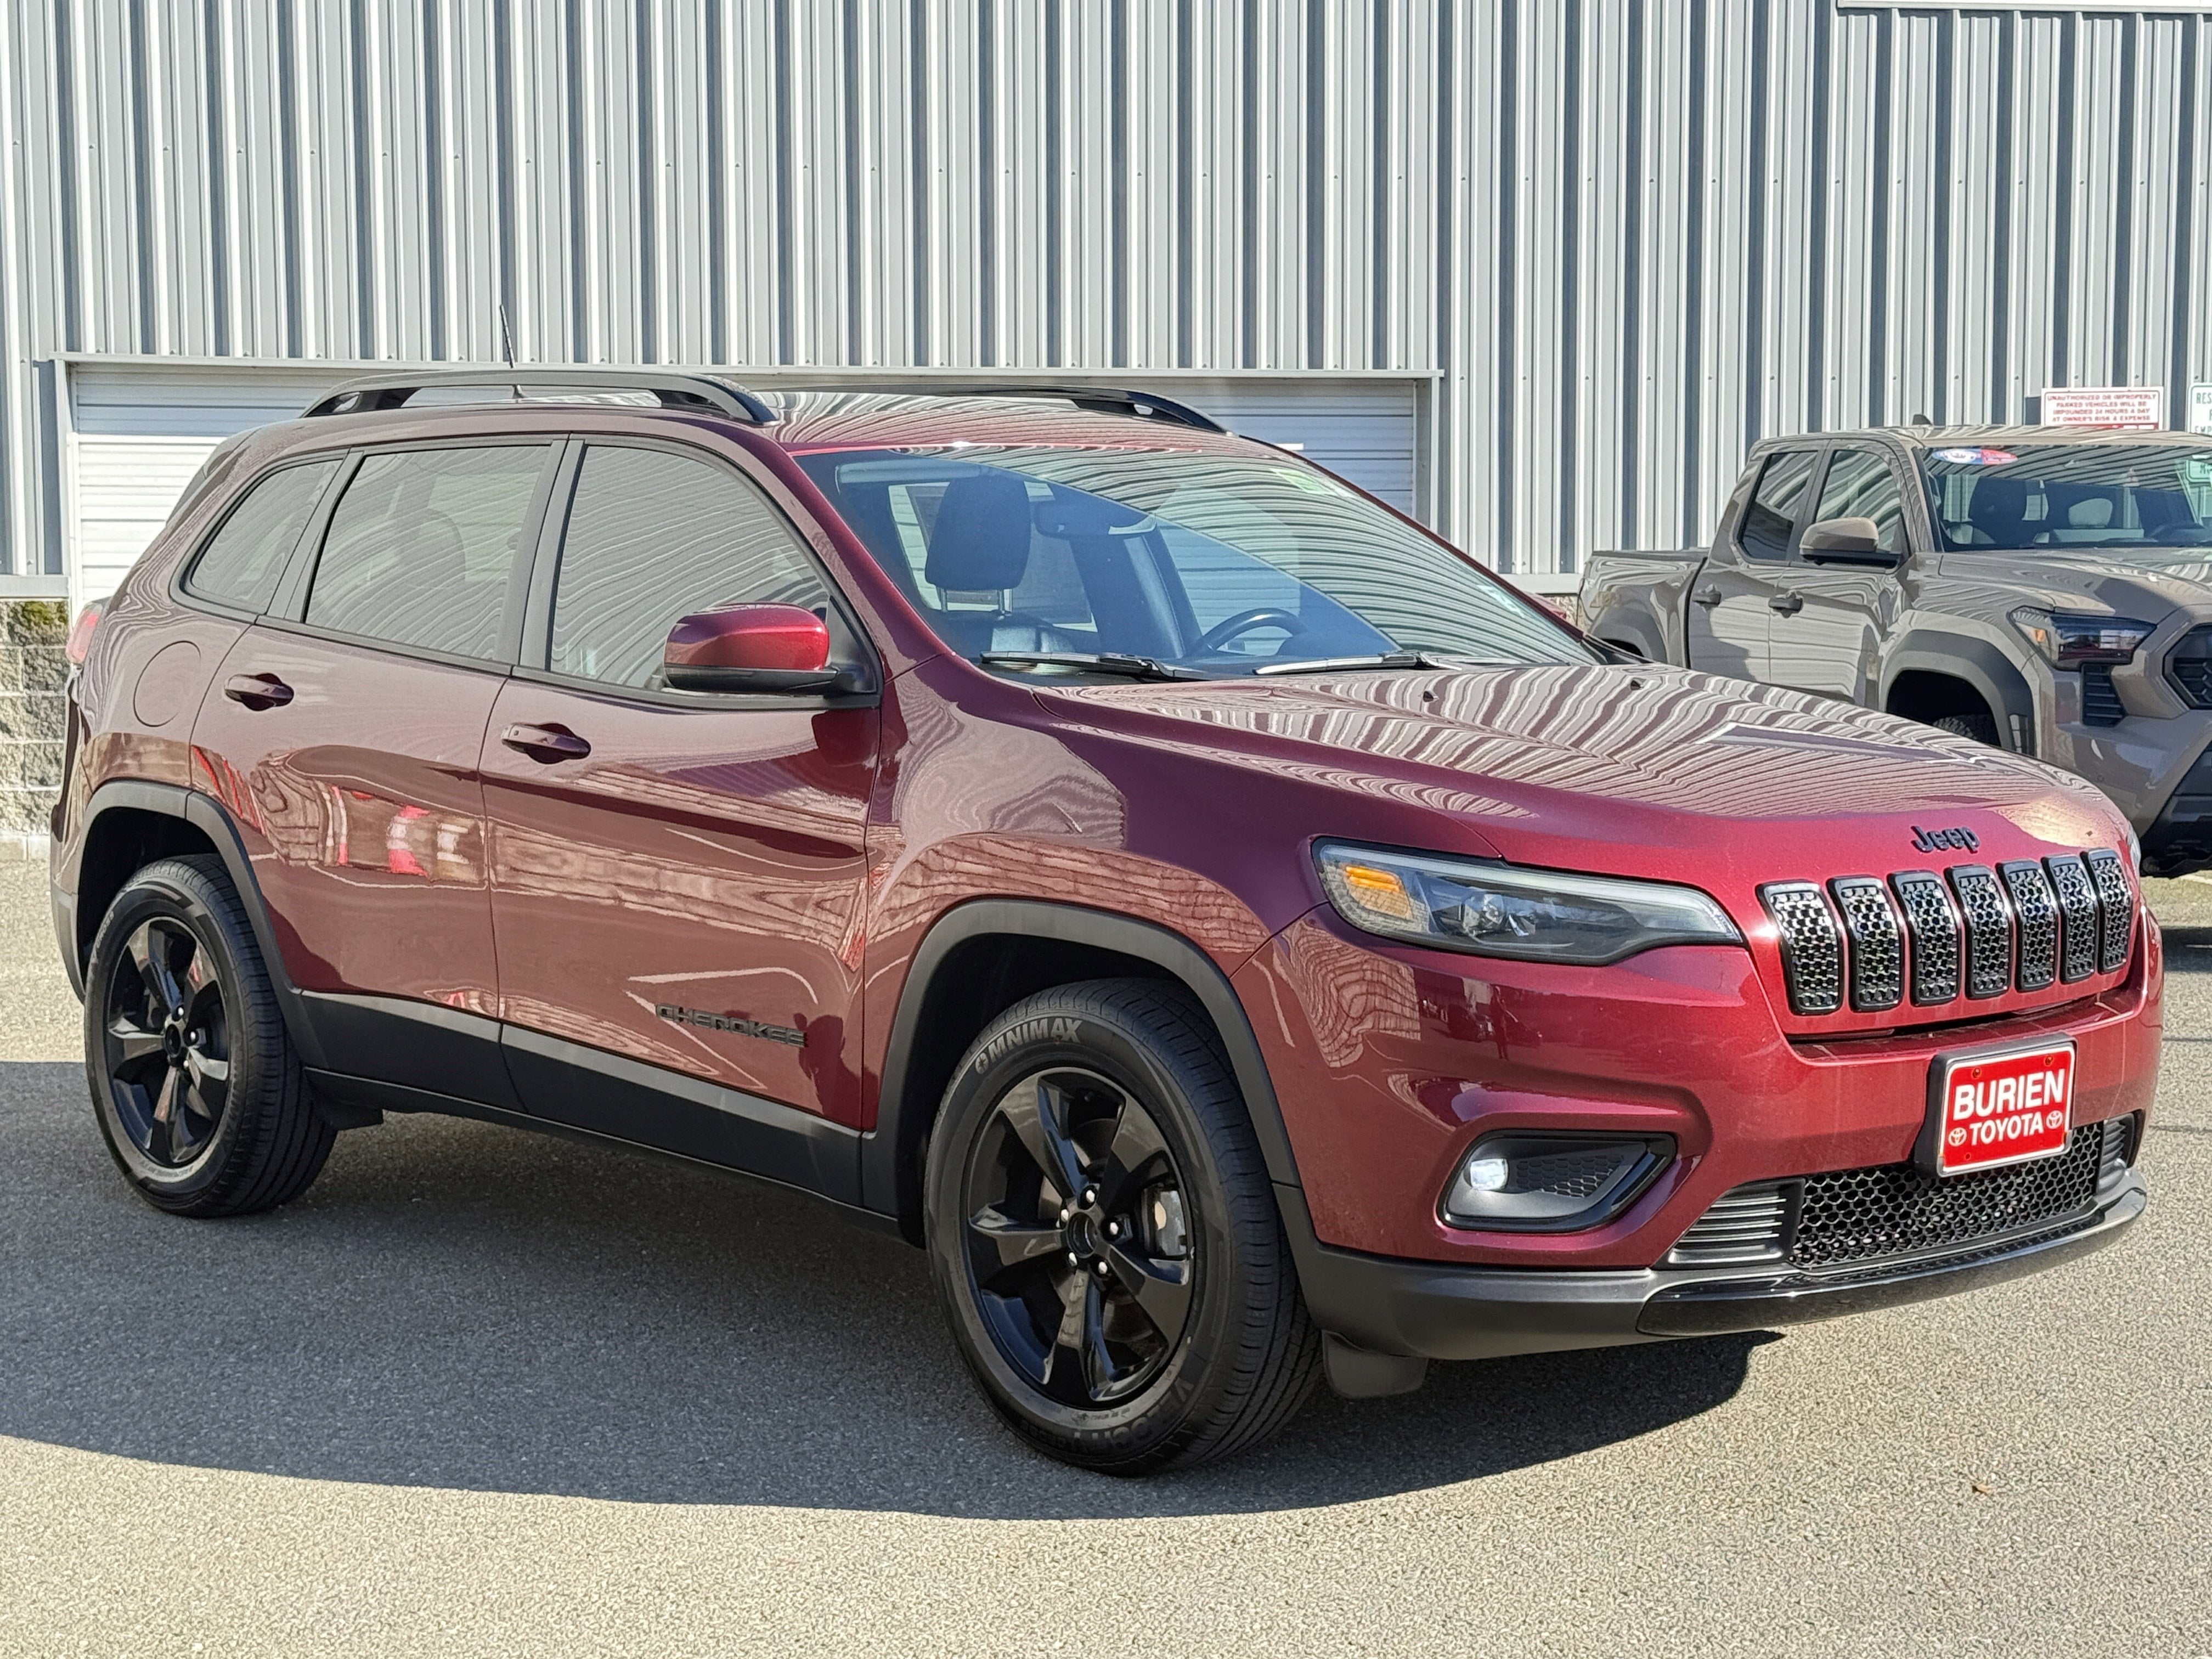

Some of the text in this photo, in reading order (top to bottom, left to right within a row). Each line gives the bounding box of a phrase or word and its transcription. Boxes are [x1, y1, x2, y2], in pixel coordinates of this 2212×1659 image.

[1911, 826, 1980, 854] Jeep
[656, 1003, 805, 1048] CHEROKEE
[975, 1018, 1083, 1074] OMNIMAX
[1953, 1069, 2065, 1120] BURIEN
[1970, 1111, 2044, 1146] TOYOTA
